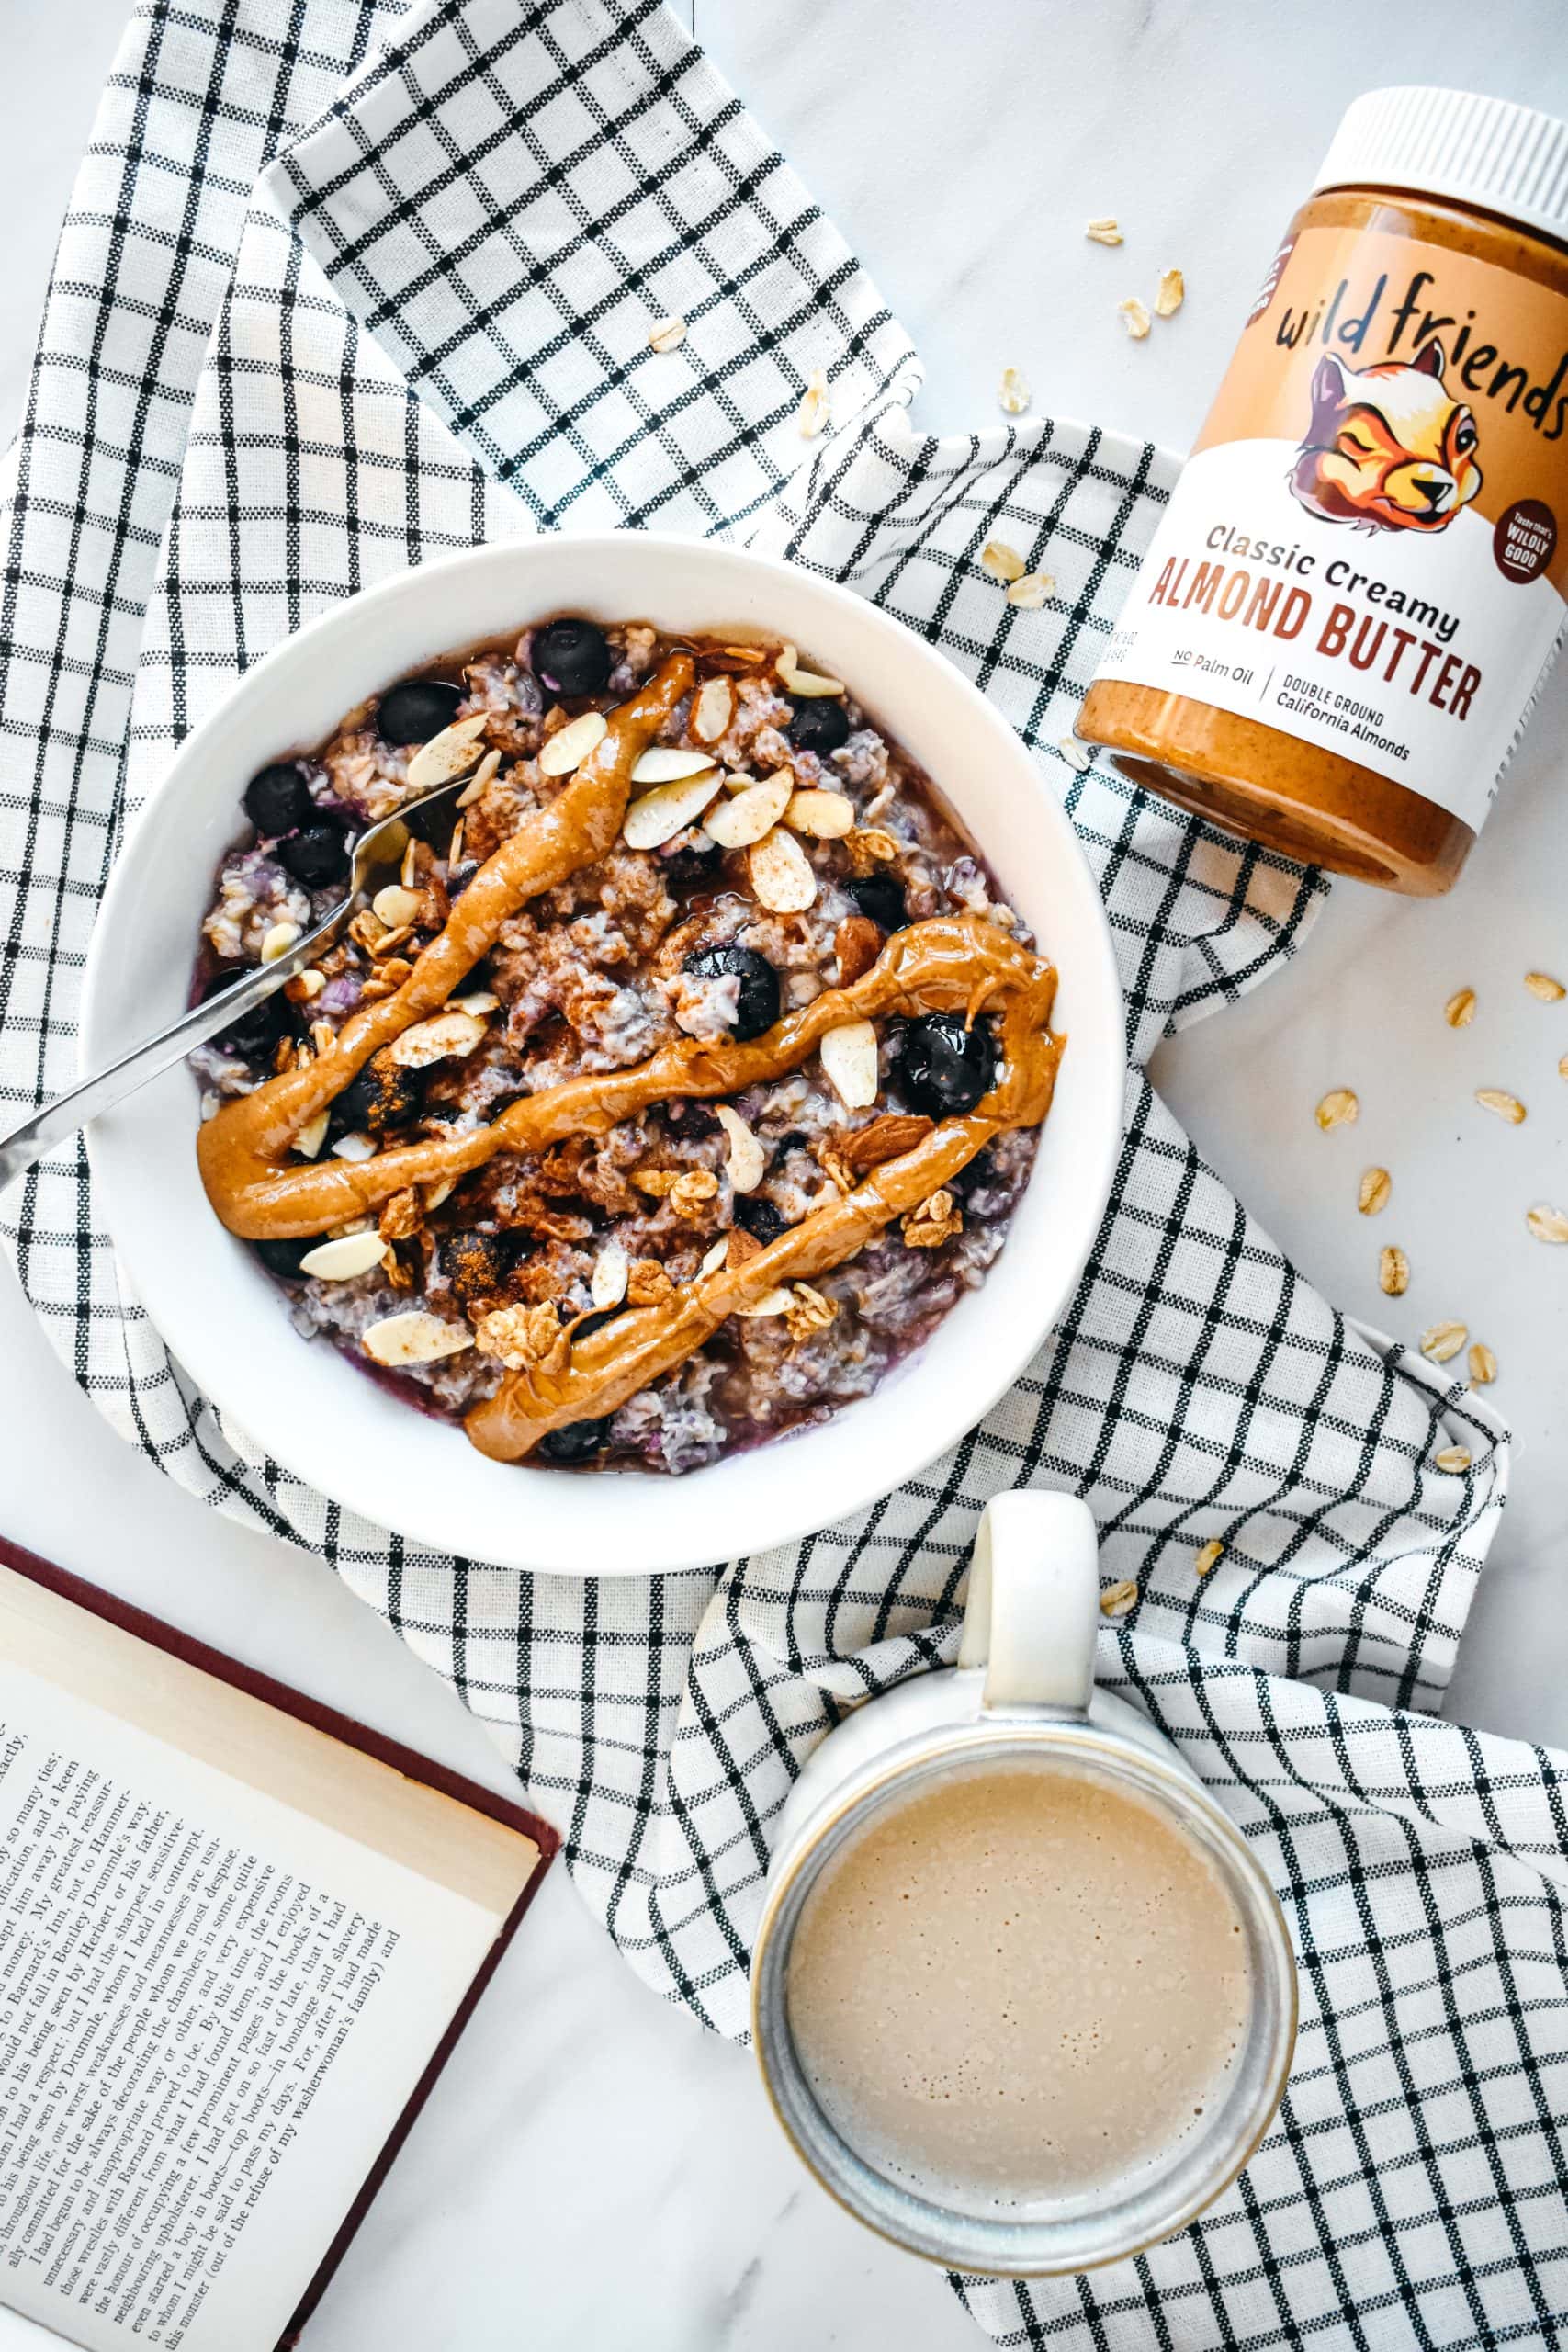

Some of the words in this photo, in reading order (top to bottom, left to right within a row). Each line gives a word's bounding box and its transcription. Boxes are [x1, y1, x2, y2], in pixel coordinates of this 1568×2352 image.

[1276, 273, 1388, 355] wild
[1386, 272, 1568, 441] friends
[1506, 522, 1549, 556] WILDLY
[1504, 543, 1537, 569] GOOD
[1205, 525, 1316, 576] Classic
[1325, 560, 1461, 643] Creamy
[1148, 556, 1313, 641] ALMOND
[1316, 602, 1483, 721] BUTTER
[1193, 654, 1230, 678] Palm
[1231, 667, 1255, 685] Oil
[1282, 674, 1333, 706] DOUBLE
[1334, 695, 1385, 728] GROUND
[1276, 691, 1350, 733] California
[1350, 722, 1411, 762] Almonds
[51, 1760, 80, 1794] keen
[6, 1826, 20, 1844] so
[16, 1785, 44, 1826] many
[37, 1751, 63, 1782] ties;
[49, 1797, 60, 1807] a
[32, 1808, 52, 1838] and
[87, 1790, 131, 1855] Hammer-
[9, 1887, 35, 1916] him
[31, 1844, 58, 1883] away
[49, 1820, 70, 1841] by
[65, 1769, 101, 1819] paying
[2, 1930, 35, 1978] money.
[28, 1894, 54, 1921] My
[50, 1838, 84, 1894] greatest
[80, 1780, 113, 1834] reassur-
[80, 1859, 96, 1873] to
[66, 1878, 85, 1902] not
[318, 1894, 330, 1904] a
[44, 1907, 73, 1936] Inn,
[276, 1882, 311, 1938] enjoyed
[309, 1904, 321, 1922] of
[322, 1901, 347, 1930] had
[265, 1939, 280, 1951] I
[280, 1925, 311, 1966] books
[316, 1931, 331, 1941] I
[332, 1912, 366, 1962] slavery
[356, 1921, 382, 1960] made
[6, 1939, 52, 2006] Barnard's
[254, 1951, 274, 1981] and
[301, 1945, 324, 1974] that
[268, 1969, 288, 1992] the
[316, 1963, 336, 1993] and
[336, 1961, 361, 1990] had
[229, 1985, 260, 2022] them,
[256, 1996, 274, 2010] in
[279, 1980, 309, 2008] late,
[330, 1990, 344, 2002] I
[0, 2010, 14, 2025] to
[275, 2008, 288, 2027] of
[278, 1996, 320, 2053] bondage
[314, 2004, 337, 2040] after
[203, 2025, 234, 2067] found
[237, 2014, 265, 2055] pages
[254, 2030, 278, 2058] fast
[7, 2245, 28, 2268] ally
[21, 2178, 61, 2244] committed
[52, 2157, 72, 2178] for
[66, 2133, 85, 2155] the
[81, 2100, 103, 2132] sake
[99, 2079, 113, 2098] of
[107, 2055, 127, 2078] the
[122, 2007, 152, 2055] people
[148, 1963, 177, 2003] whom
[172, 1939, 189, 1958] we
[185, 1903, 209, 1937] most
[203, 1849, 241, 1899] despise.
[247, 2061, 262, 2077] so
[292, 2044, 320, 2073] For,
[43, 2218, 87, 2287] unnecessary
[81, 2188, 100, 2216] and
[92, 2099, 149, 2188] inappropriate
[144, 2066, 168, 2094] way
[164, 2046, 176, 2063] or
[175, 2004, 204, 2042] other,
[198, 1969, 219, 1998] and
[215, 1933, 239, 1963] very
[235, 1864, 276, 1930] expensive
[60, 2266, 83, 2296] those
[77, 2217, 109, 2264] wrestles
[104, 2188, 125, 2214] with
[117, 2128, 155, 2185] Barnard
[150, 2079, 182, 2131] proved
[175, 2064, 191, 2078] to
[183, 2042, 205, 2062] be.
[198, 2011, 220, 2033] By
[213, 1982, 235, 2008] this
[230, 1947, 257, 1979] time,
[250, 1918, 269, 1941] the
[265, 1873, 294, 1917] rooms
[186, 2069, 210, 2098] had
[236, 2080, 252, 2098] on
[179, 2099, 194, 2110] I
[197, 2056, 242, 2129] prominent
[270, 2082, 299, 2116] days.
[163, 2113, 188, 2145] what
[221, 2101, 240, 2127] got
[164, 2329, 185, 2351] this
[178, 2280, 210, 2329] monster
[204, 2251, 228, 2278] (out
[223, 2232, 236, 2249] of
[230, 2210, 250, 2232] the
[244, 2166, 273, 2208] refuse
[269, 2146, 283, 2165] of
[278, 2123, 298, 2147] my
[291, 2016, 355, 2120] washerwoman's
[347, 1962, 385, 2014] family)
[381, 1929, 400, 1959] and
[179, 2128, 201, 2154] few
[201, 2125, 226, 2154] had
[257, 2121, 277, 2143] my
[141, 2151, 168, 2183] from
[175, 2157, 187, 2168] a
[195, 2154, 209, 2166] I
[240, 2145, 262, 2177] pass
[229, 2177, 244, 2192] to
[113, 2186, 149, 2238] different
[141, 2169, 183, 2233] occupying
[154, 2175, 202, 2247] upholsterer.
[189, 2204, 207, 2219] in
[214, 2193, 235, 2224] said
[131, 2233, 144, 2250] of
[174, 2222, 198, 2247] boy
[199, 2225, 219, 2242] be
[93, 2239, 120, 2275] vastly
[171, 2250, 183, 2260] a
[183, 2245, 209, 2281] might
[103, 2252, 135, 2295] honour
[113, 2248, 163, 2325] neighbouring
[147, 2260, 175, 2305] started
[173, 2280, 187, 2291] I
[78, 2278, 98, 2304] were
[94, 2295, 112, 2315] the
[131, 2307, 152, 2334] even
[156, 2293, 182, 2326] whom
[147, 2329, 162, 2342] to
